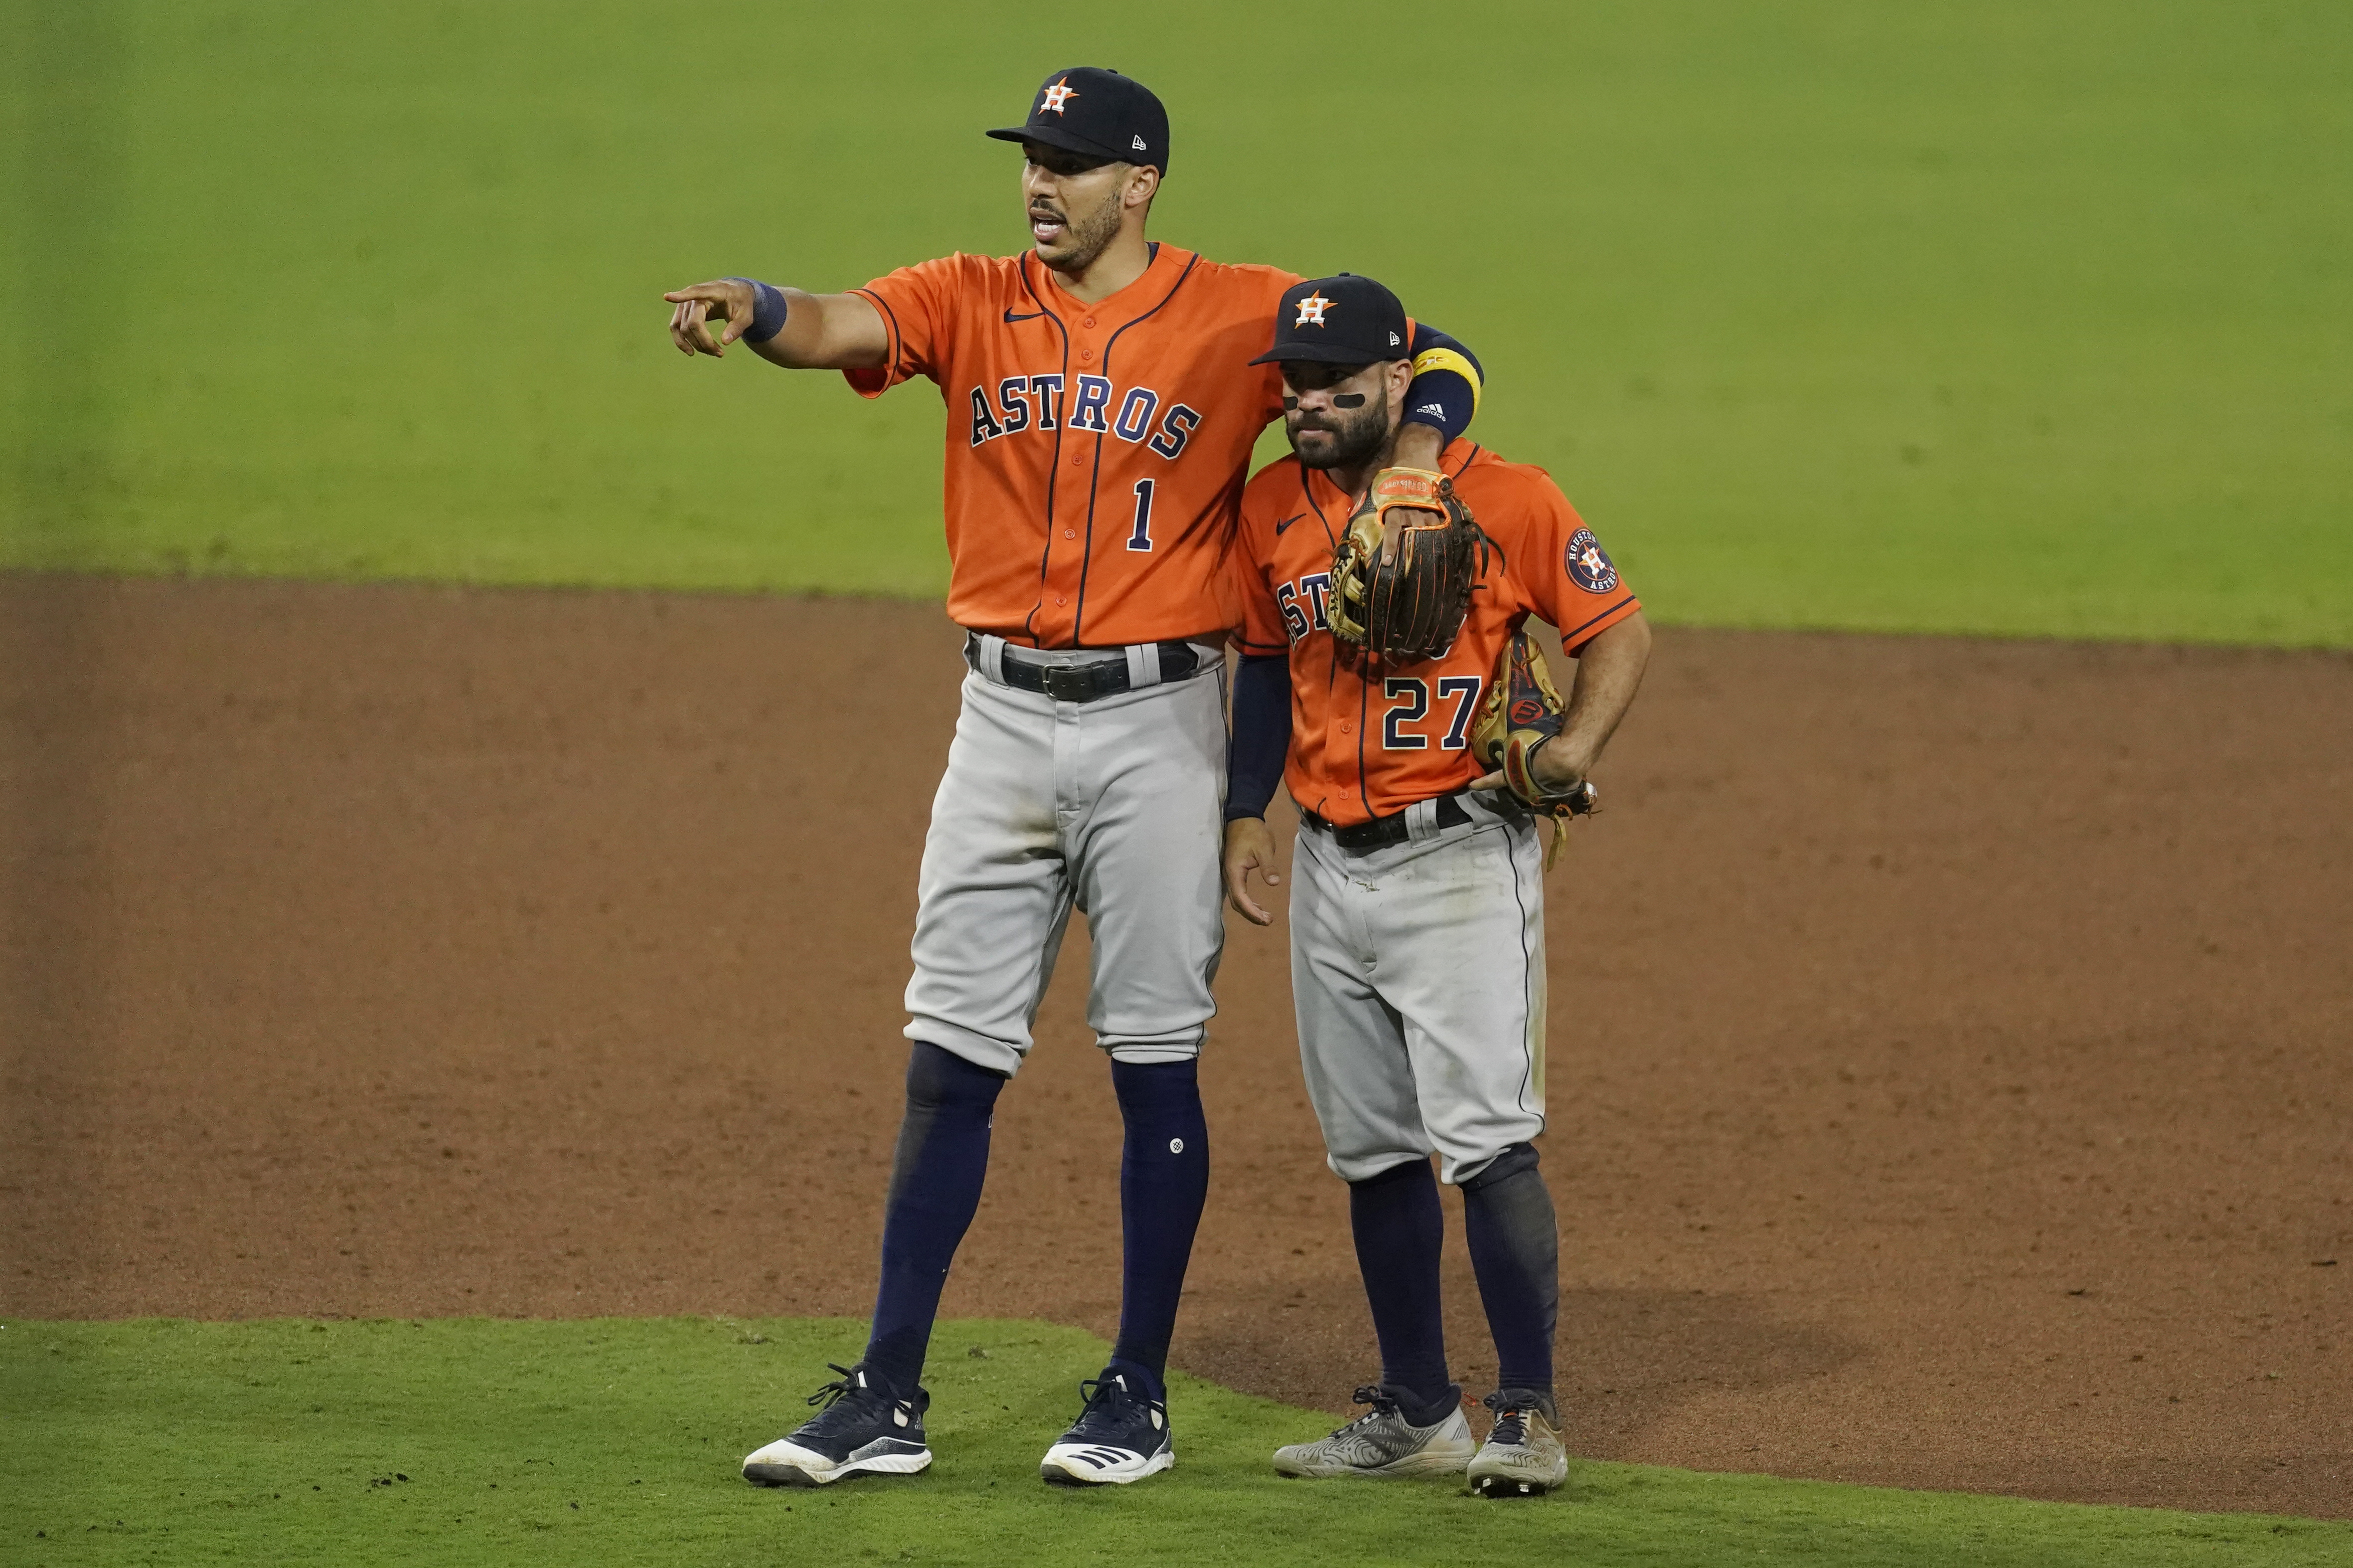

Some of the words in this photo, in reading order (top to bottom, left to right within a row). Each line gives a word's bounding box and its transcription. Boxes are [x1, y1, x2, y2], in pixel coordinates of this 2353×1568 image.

[1040, 85, 1073, 112] H
[1296, 297, 1329, 323] H
[970, 374, 1202, 460] ASTROS
[1417, 408, 1446, 422] adidas
[1126, 478, 1155, 552] 1
[1569, 532, 1596, 560] HOUSTON
[1582, 547, 1605, 576] H
[1590, 566, 1616, 590] ASTROS
[1383, 675, 1482, 750] 27
